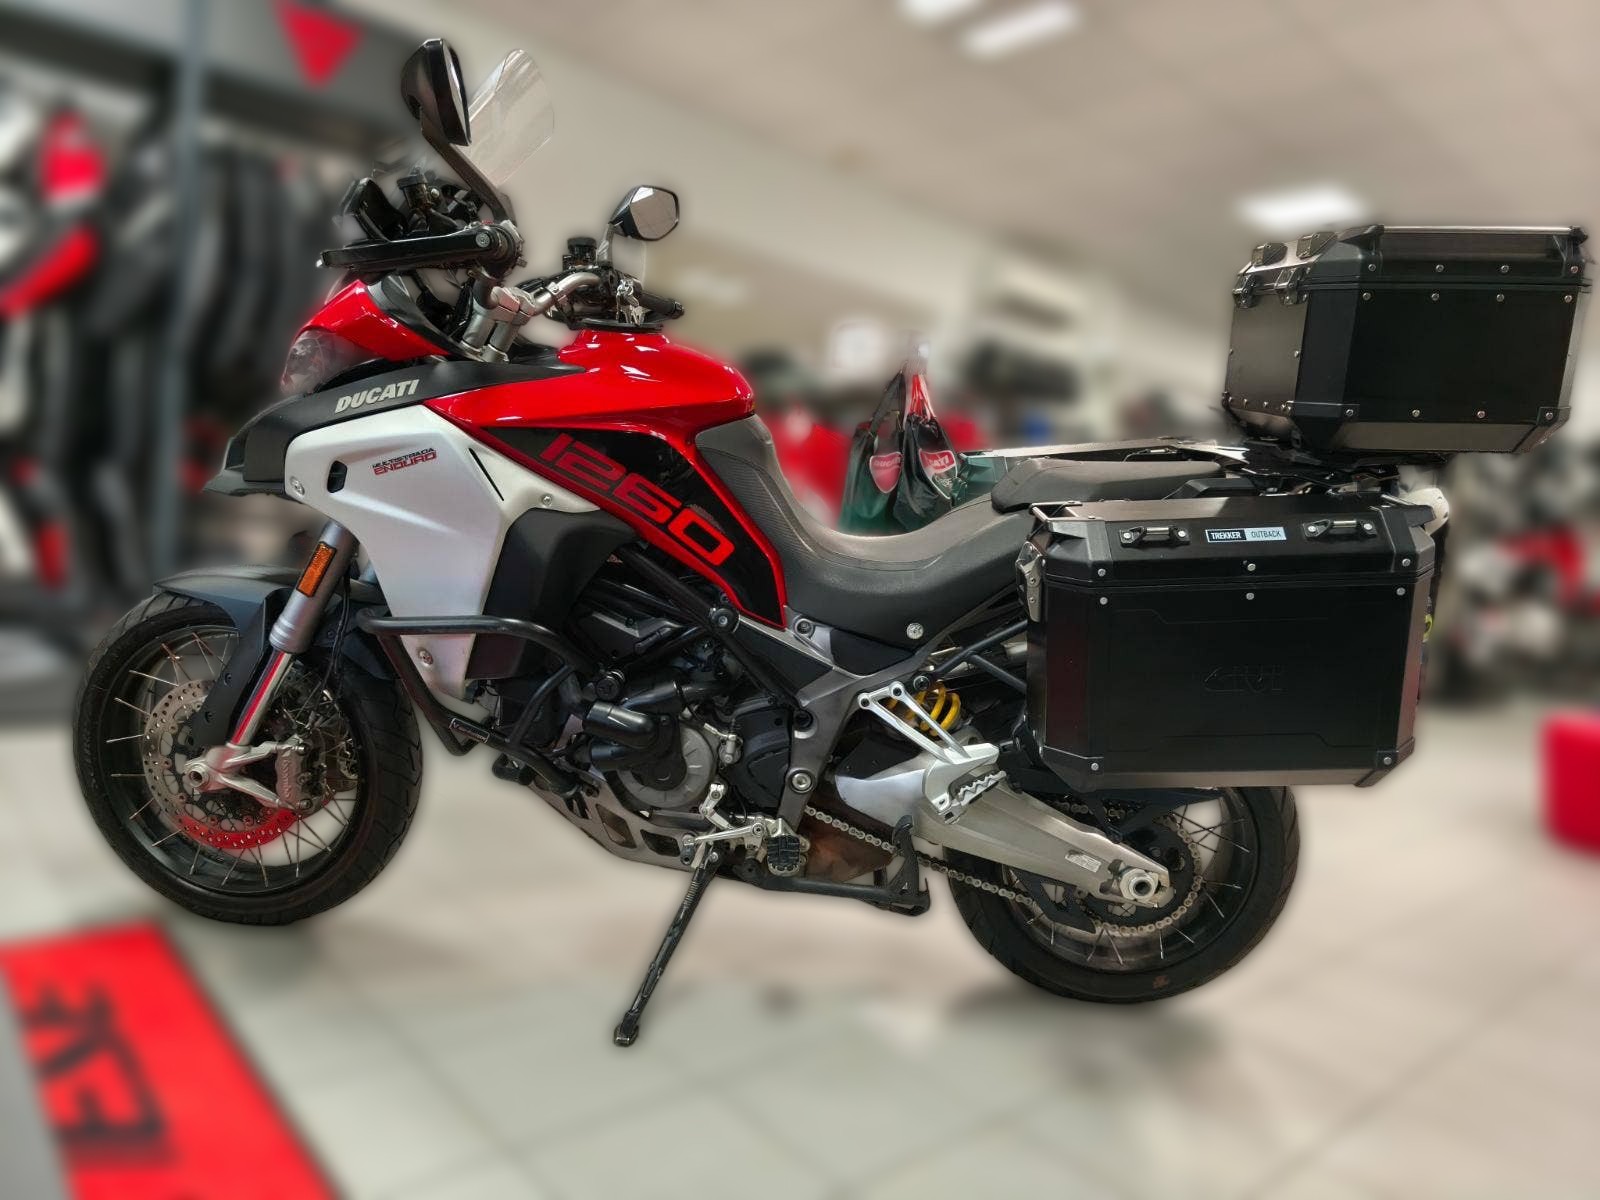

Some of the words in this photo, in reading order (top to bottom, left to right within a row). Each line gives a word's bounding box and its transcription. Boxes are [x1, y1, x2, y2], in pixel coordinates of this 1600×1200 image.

[335, 379, 420, 413] DUCATI
[374, 450, 437, 475] ENDURO
[539, 433, 735, 566] 1260
[1210, 531, 1242, 540] TREKKER
[1250, 530, 1281, 539] OUTBACK
